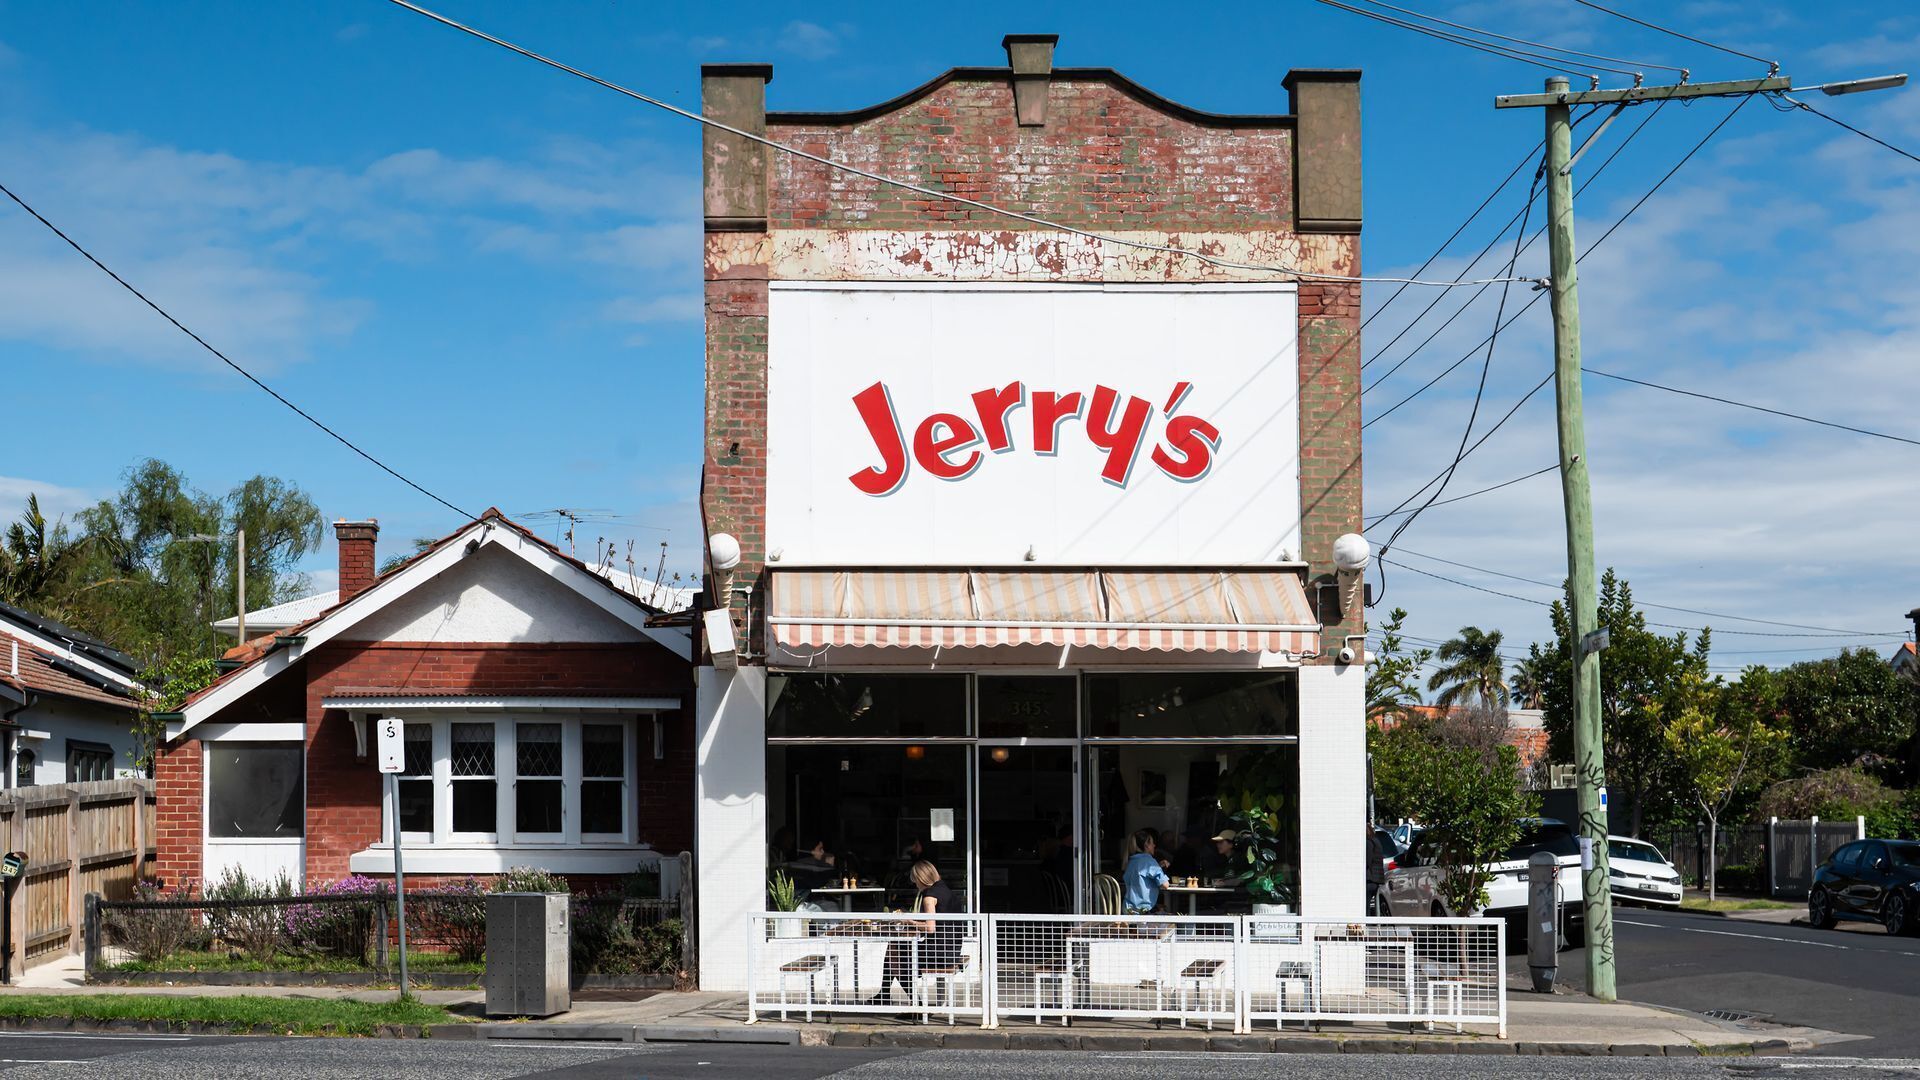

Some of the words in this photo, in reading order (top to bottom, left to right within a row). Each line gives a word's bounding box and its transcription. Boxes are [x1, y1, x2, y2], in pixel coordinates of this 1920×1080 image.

[848, 381, 1223, 497] Jerry's
[1010, 701, 1042, 716] 345
[3, 865, 18, 875] 347
